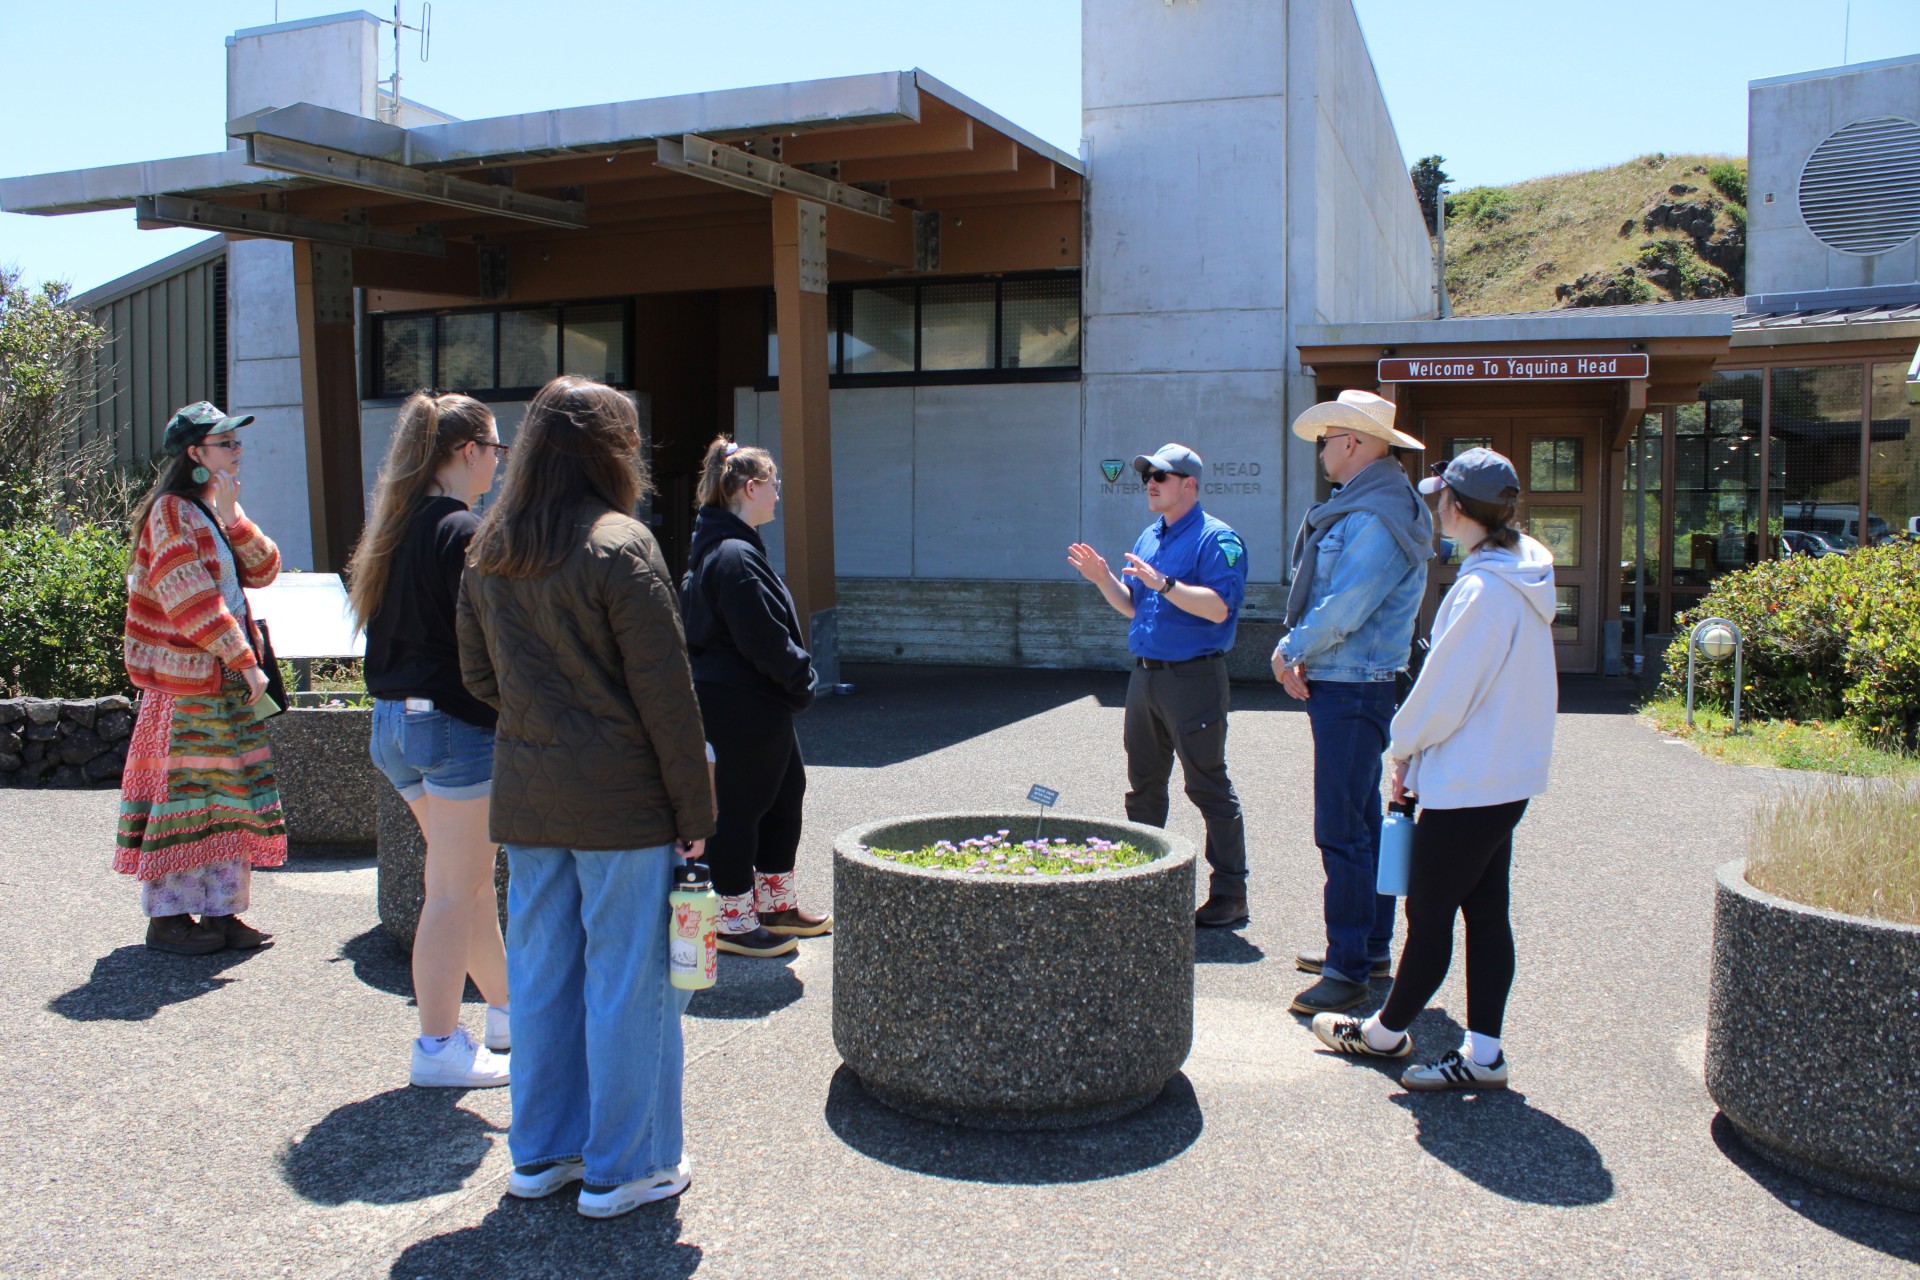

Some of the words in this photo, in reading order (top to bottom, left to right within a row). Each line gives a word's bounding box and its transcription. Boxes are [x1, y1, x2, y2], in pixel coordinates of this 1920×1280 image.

[1408, 361, 1475, 377] Welcome
[1482, 360, 1499, 375] To
[1507, 359, 1568, 378] Yaquina
[1578, 358, 1617, 374] Head
[1212, 462, 1261, 477] HEAD
[1101, 483, 1149, 495] INTERP
[1204, 482, 1261, 496] CENTER
